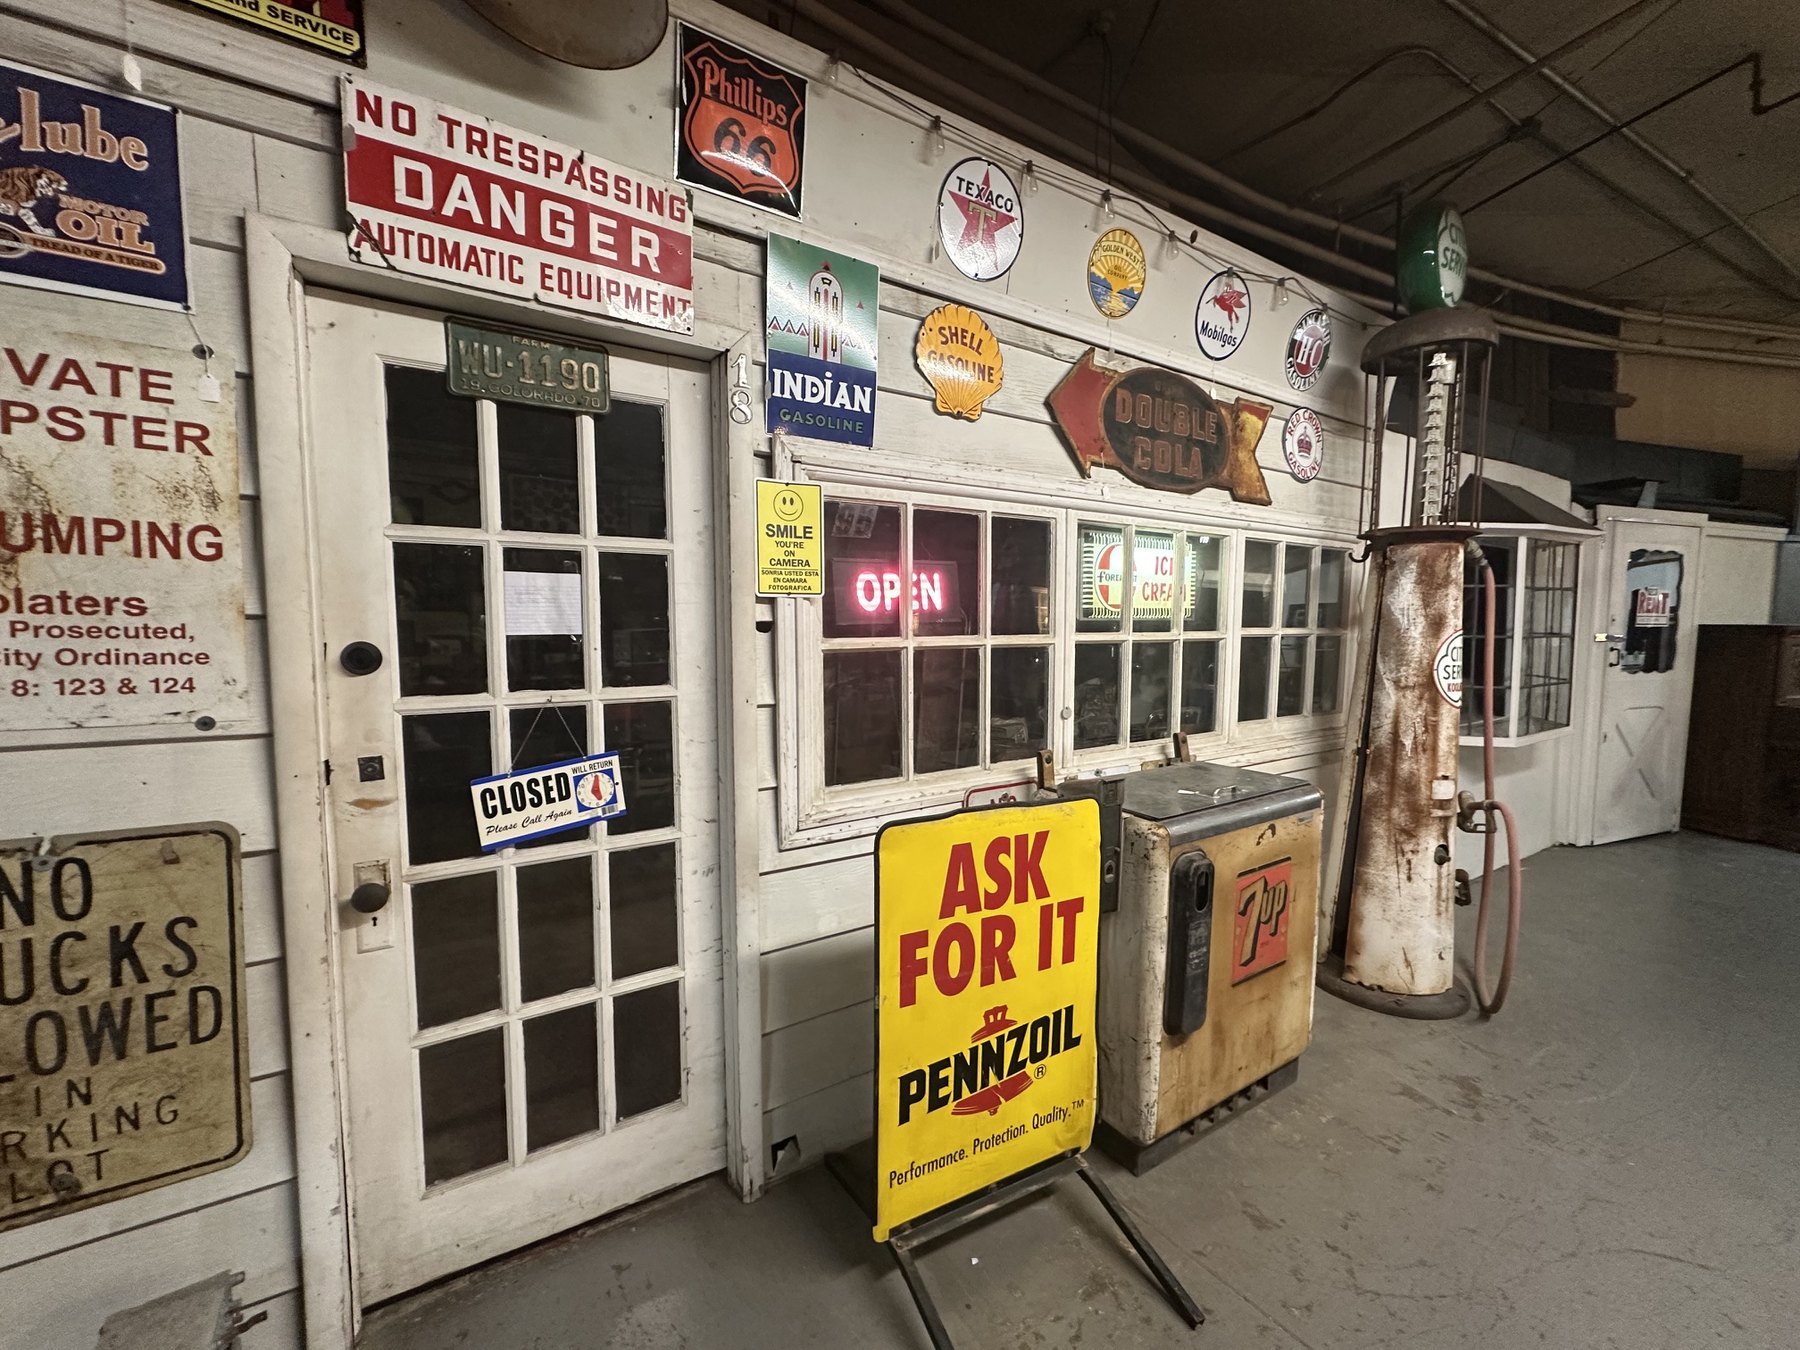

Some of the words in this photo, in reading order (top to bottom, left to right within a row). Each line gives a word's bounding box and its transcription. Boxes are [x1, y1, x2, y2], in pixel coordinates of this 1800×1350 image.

[267, 4, 355, 46] SERVICE
[696, 56, 789, 126] Phillips
[356, 89, 417, 137] NO
[438, 114, 687, 223] TRESPASSING
[713, 117, 777, 178] 66
[58, 193, 150, 226] MOTOR
[956, 175, 1014, 213] TEXACO
[56, 209, 156, 255] OIL
[393, 154, 661, 274] DANGER
[31, 237, 82, 255] TREAD
[84, 247, 102, 260] OF
[105, 252, 116, 262] A
[117, 254, 160, 271] TIGER
[353, 217, 525, 286] AUTOMATIC
[539, 261, 692, 319] EQUIPMENT
[1102, 244, 1124, 256] GOLDEN
[1125, 248, 1140, 266] WEST
[512, 335, 551, 350] FARM
[937, 324, 983, 356] SHELL
[1199, 319, 1238, 348] Mobilgas
[2, 346, 175, 405] VATE
[927, 350, 995, 384] GASOLINE
[488, 383, 576, 405] COLORADO
[0, 398, 215, 457] PSTER
[779, 408, 864, 434] GASOLINE
[1115, 386, 1218, 445] DOUBLE
[1287, 412, 1301, 436] RED
[1302, 409, 1322, 444] CROWN
[1133, 435, 1203, 480] COLA
[1288, 451, 1320, 480] GASOLINE
[0, 511, 225, 562] UMPING
[765, 523, 813, 540] SMILE
[775, 540, 804, 549] YOU'RE
[769, 558, 811, 568] CAMERA
[784, 550, 796, 558] ON
[761, 569, 783, 577] SONRIA
[768, 584, 812, 592] FOTOGRAFICA
[9, 620, 196, 644] Prosecuted,
[0, 648, 42, 672] ity
[54, 648, 210, 668] Ordinance
[11, 679, 40, 697] 8:
[52, 677, 106, 696] 123
[117, 678, 138, 695] &
[149, 676, 196, 694] 124
[571, 765, 588, 775] WILL
[588, 760, 613, 771] RETURN
[480, 771, 572, 820] CLOSED
[486, 821, 518, 836] Please
[521, 814, 542, 829] Call
[544, 808, 573, 823] Again
[0, 856, 93, 930] NO
[938, 830, 1051, 920] ASK
[899, 914, 1017, 1009] FOR
[1038, 896, 1085, 972] IT
[897, 1004, 1083, 1127] PENNZOIL
[34, 1076, 92, 1118] IN
[1, 1094, 180, 1165] RKING
[889, 1148, 969, 1188] Performance.
[973, 1123, 1029, 1155] Protection.
[9, 1148, 110, 1205] LOT
